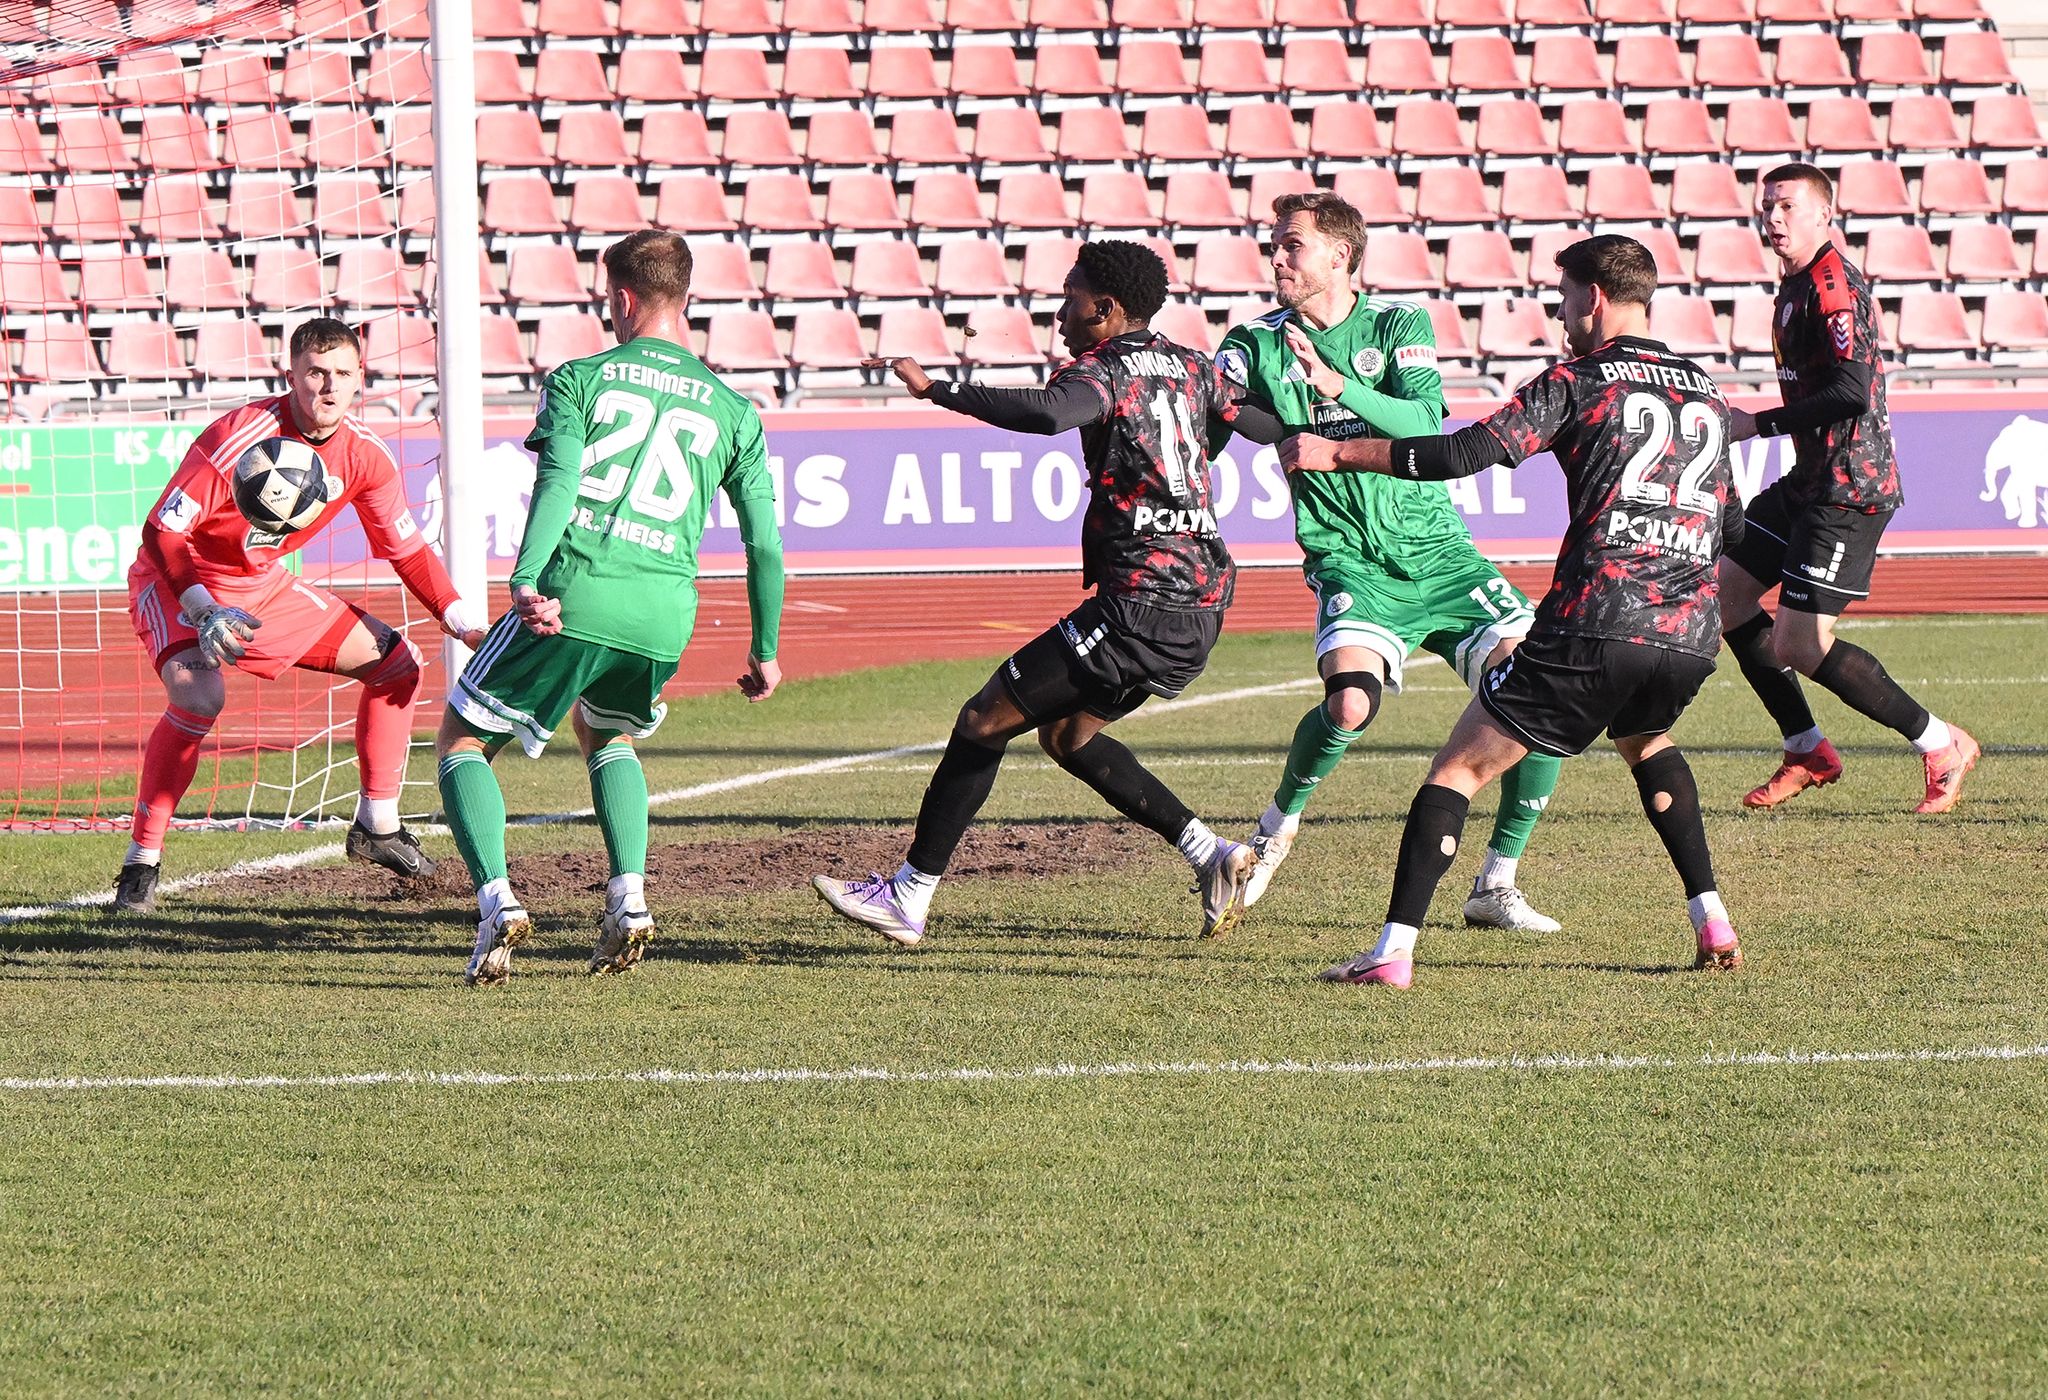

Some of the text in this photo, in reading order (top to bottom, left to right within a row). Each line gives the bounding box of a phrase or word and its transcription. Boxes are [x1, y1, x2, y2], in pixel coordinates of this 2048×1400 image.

[602, 362, 714, 406] STEINMETZ
[114, 430, 150, 465] KS
[578, 389, 720, 522] 26
[1149, 389, 1206, 497] 11
[1621, 392, 1722, 518] 22
[883, 450, 1082, 525] ALTO
[1607, 511, 1713, 560] POLYMA
[292, 583, 328, 612] 1
[1468, 577, 1522, 620] 13
